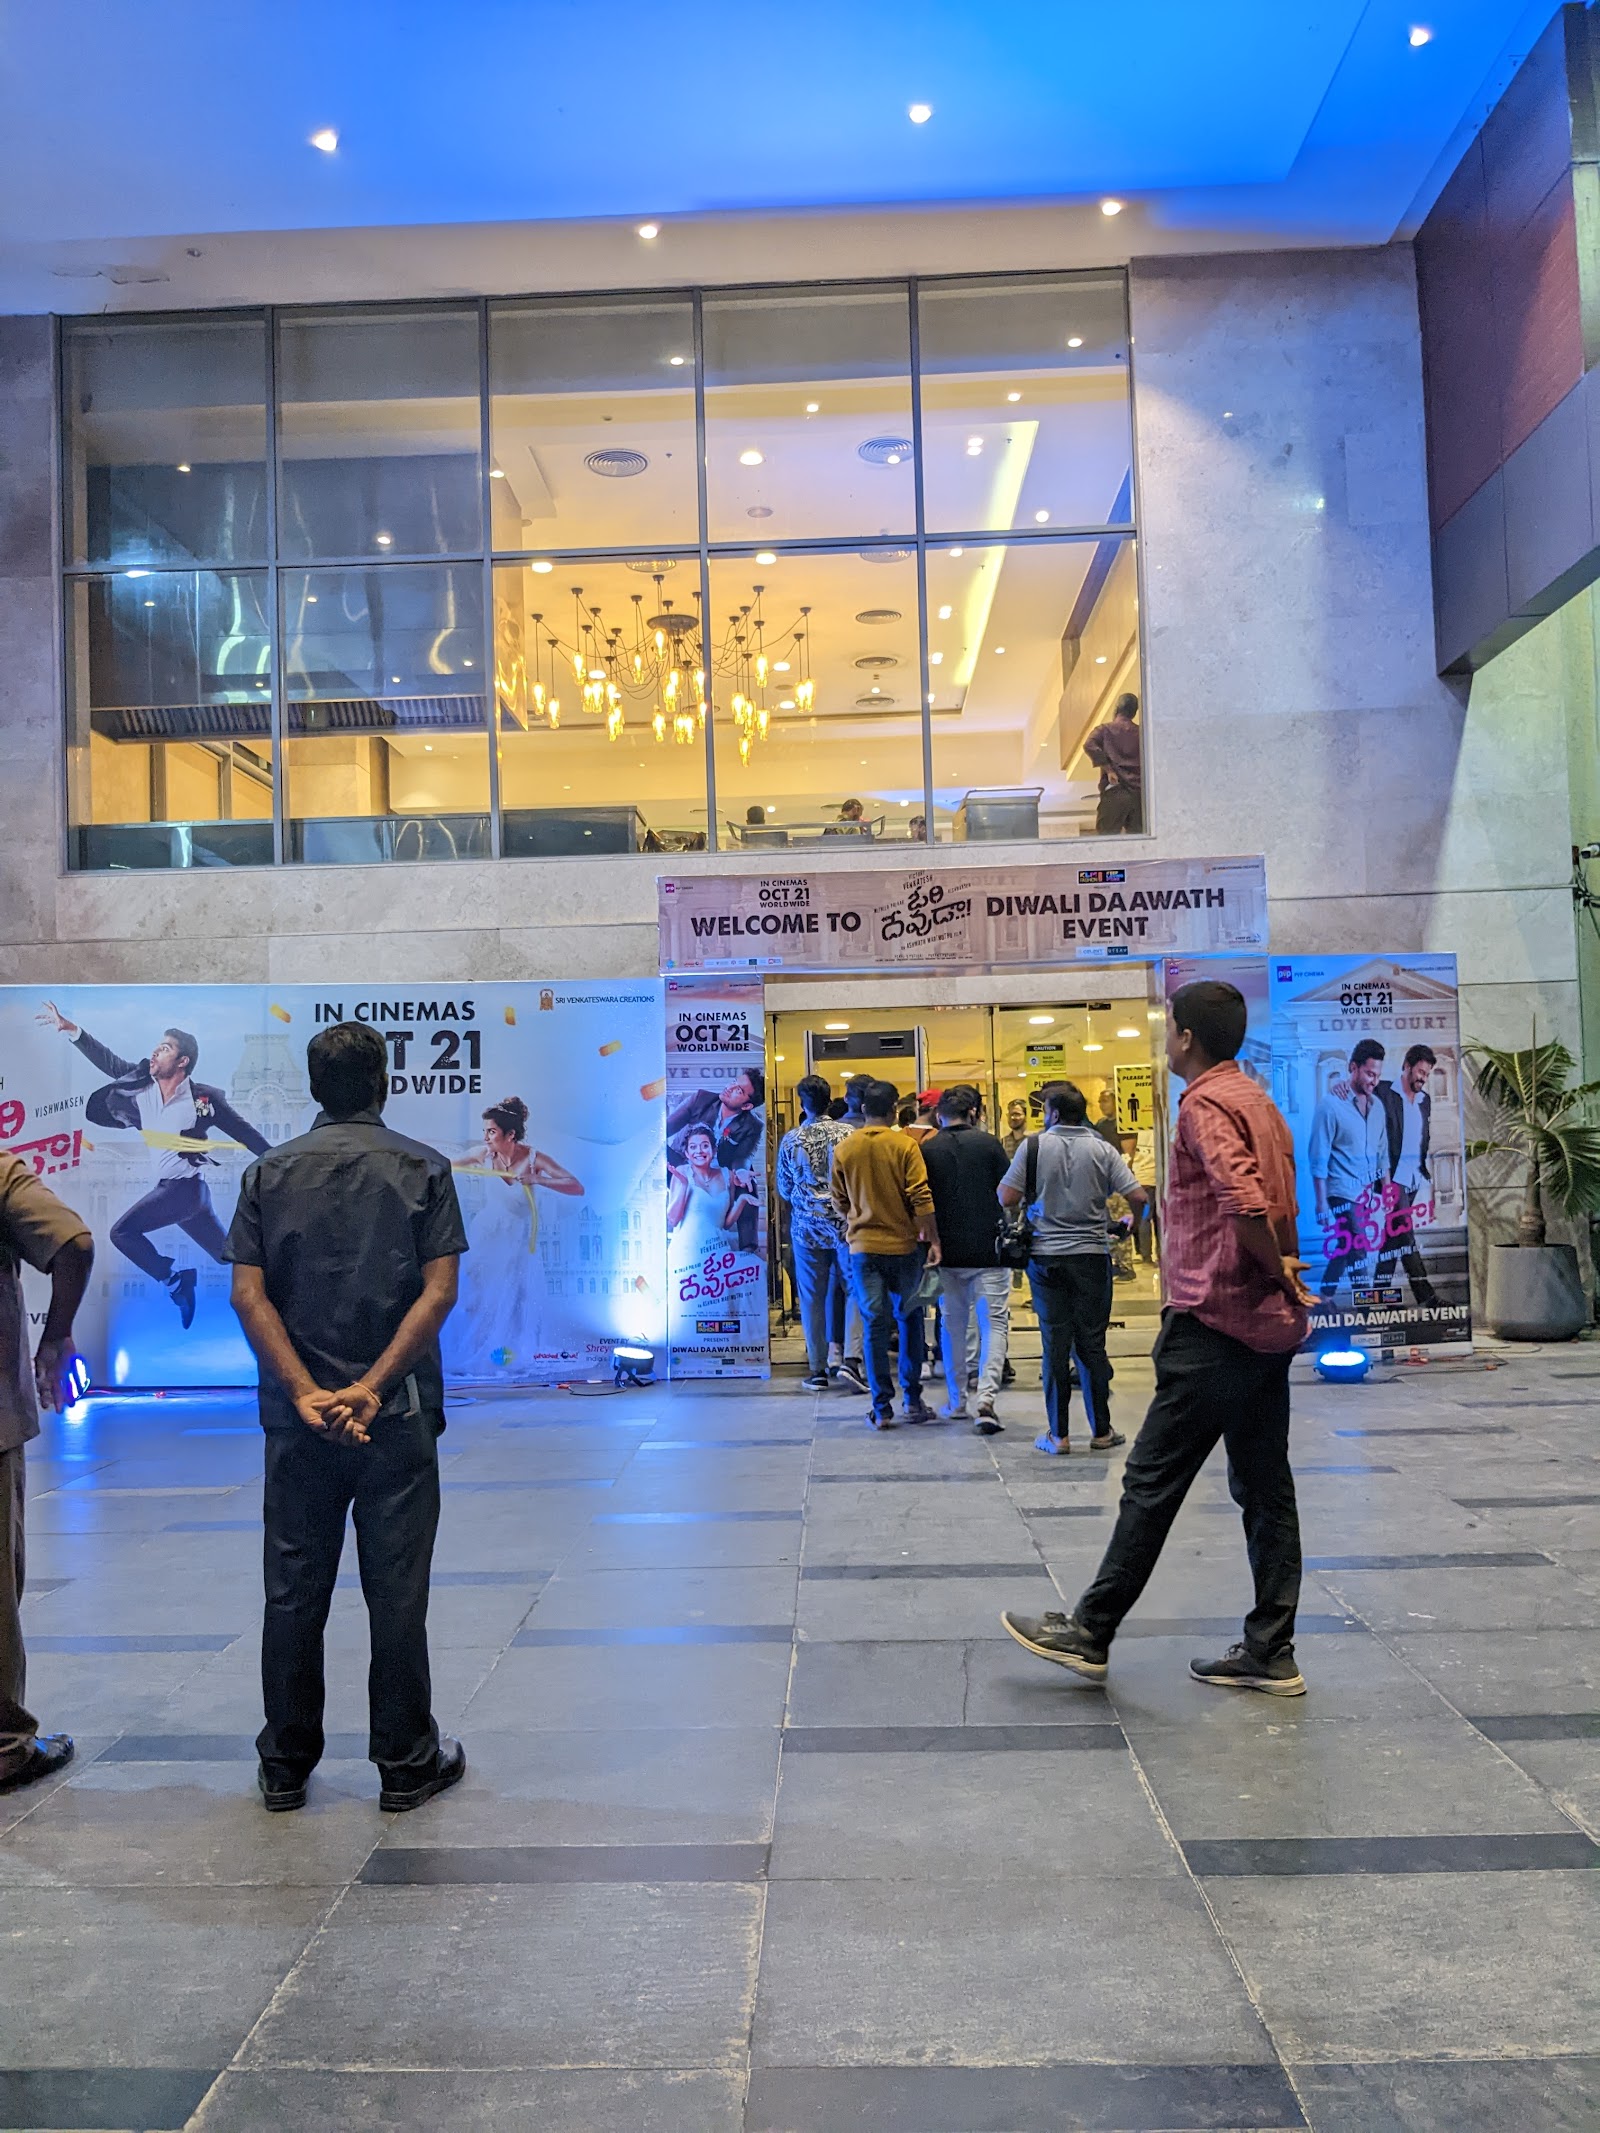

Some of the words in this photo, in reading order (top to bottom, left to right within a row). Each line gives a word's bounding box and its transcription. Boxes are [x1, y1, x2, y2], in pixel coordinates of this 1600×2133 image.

[902, 874, 933, 890] VENKATESH
[758, 888, 790, 901] OCT
[794, 887, 810, 900] 21
[759, 900, 810, 908] WORLDWIDE
[987, 894, 1080, 917] DIWALI
[1088, 888, 1225, 914] DAAWATH
[691, 913, 819, 936] WELCOME
[826, 911, 861, 932] TO
[1063, 917, 1149, 939] EVENT
[1353, 982, 1391, 990] CINEMAS
[566, 996, 618, 1004] VENKATESWARA
[619, 995, 655, 1003] CREATIONS
[1339, 992, 1372, 1006] OCT
[1377, 992, 1393, 1005] 21
[315, 1003, 343, 1023] IN
[354, 1000, 476, 1022] CINEMAS
[678, 1013, 691, 1022] IN
[695, 1012, 747, 1022] CINEMAS
[1341, 1006, 1393, 1015] WORLDWIDE
[1319, 1018, 1373, 1032] LOVE
[1381, 1016, 1447, 1030] COURT
[675, 1025, 721, 1042] OCT
[727, 1024, 749, 1042] 21
[430, 1030, 481, 1070] 21
[676, 1043, 750, 1052] WORLDWIDE
[667, 1067, 690, 1079] VE
[700, 1067, 754, 1079] COU
[391, 1075, 482, 1095] DWIDE
[34, 1095, 84, 1118] VISHWAKSEN
[700, 1240, 728, 1254] VENKATESH
[1308, 1314, 1341, 1329] WALI
[1344, 1308, 1419, 1327] DAAWATH
[1422, 1306, 1469, 1321] EVENT
